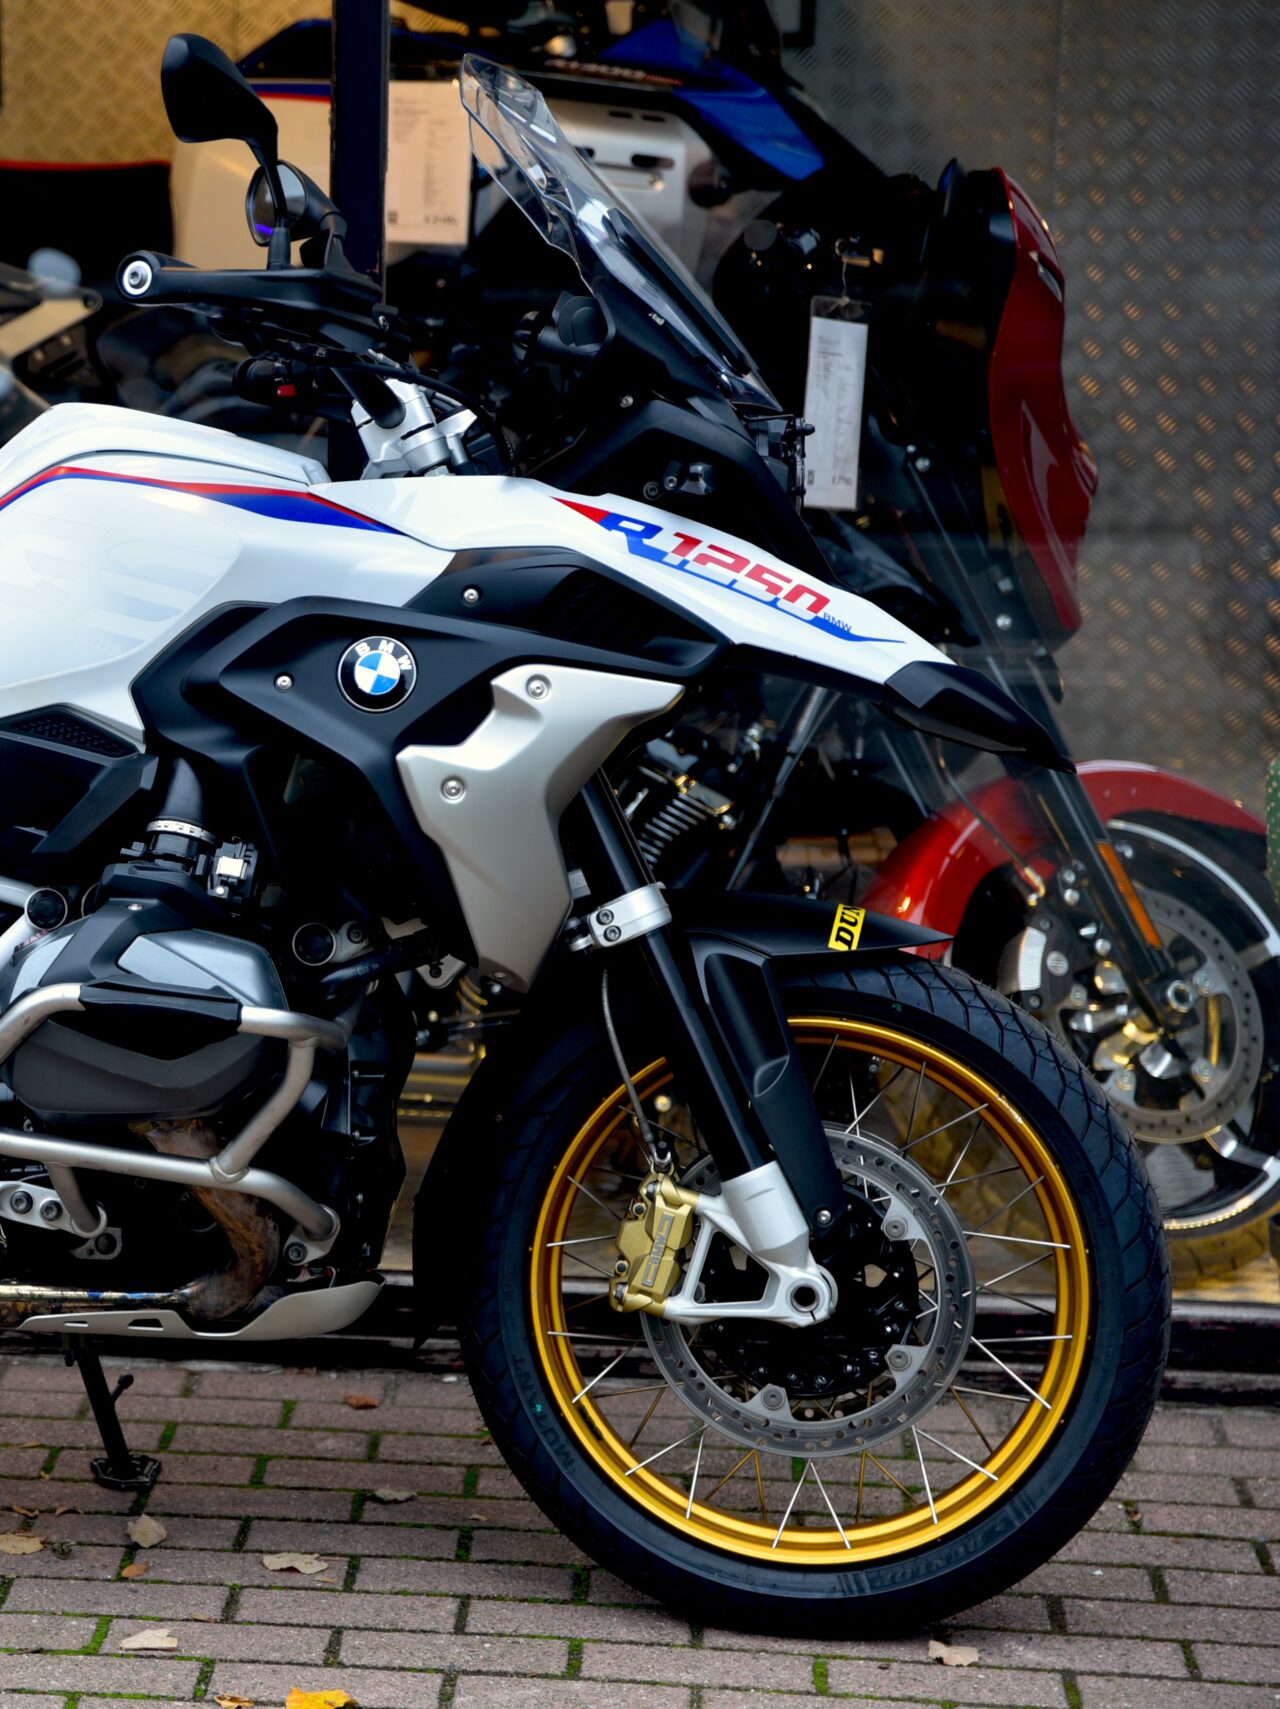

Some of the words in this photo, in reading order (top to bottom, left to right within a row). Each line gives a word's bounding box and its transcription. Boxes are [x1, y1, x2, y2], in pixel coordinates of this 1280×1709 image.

[822, 611, 852, 632] BMW
[354, 639, 413, 670] BMW
[648, 1233, 666, 1265] BMW
